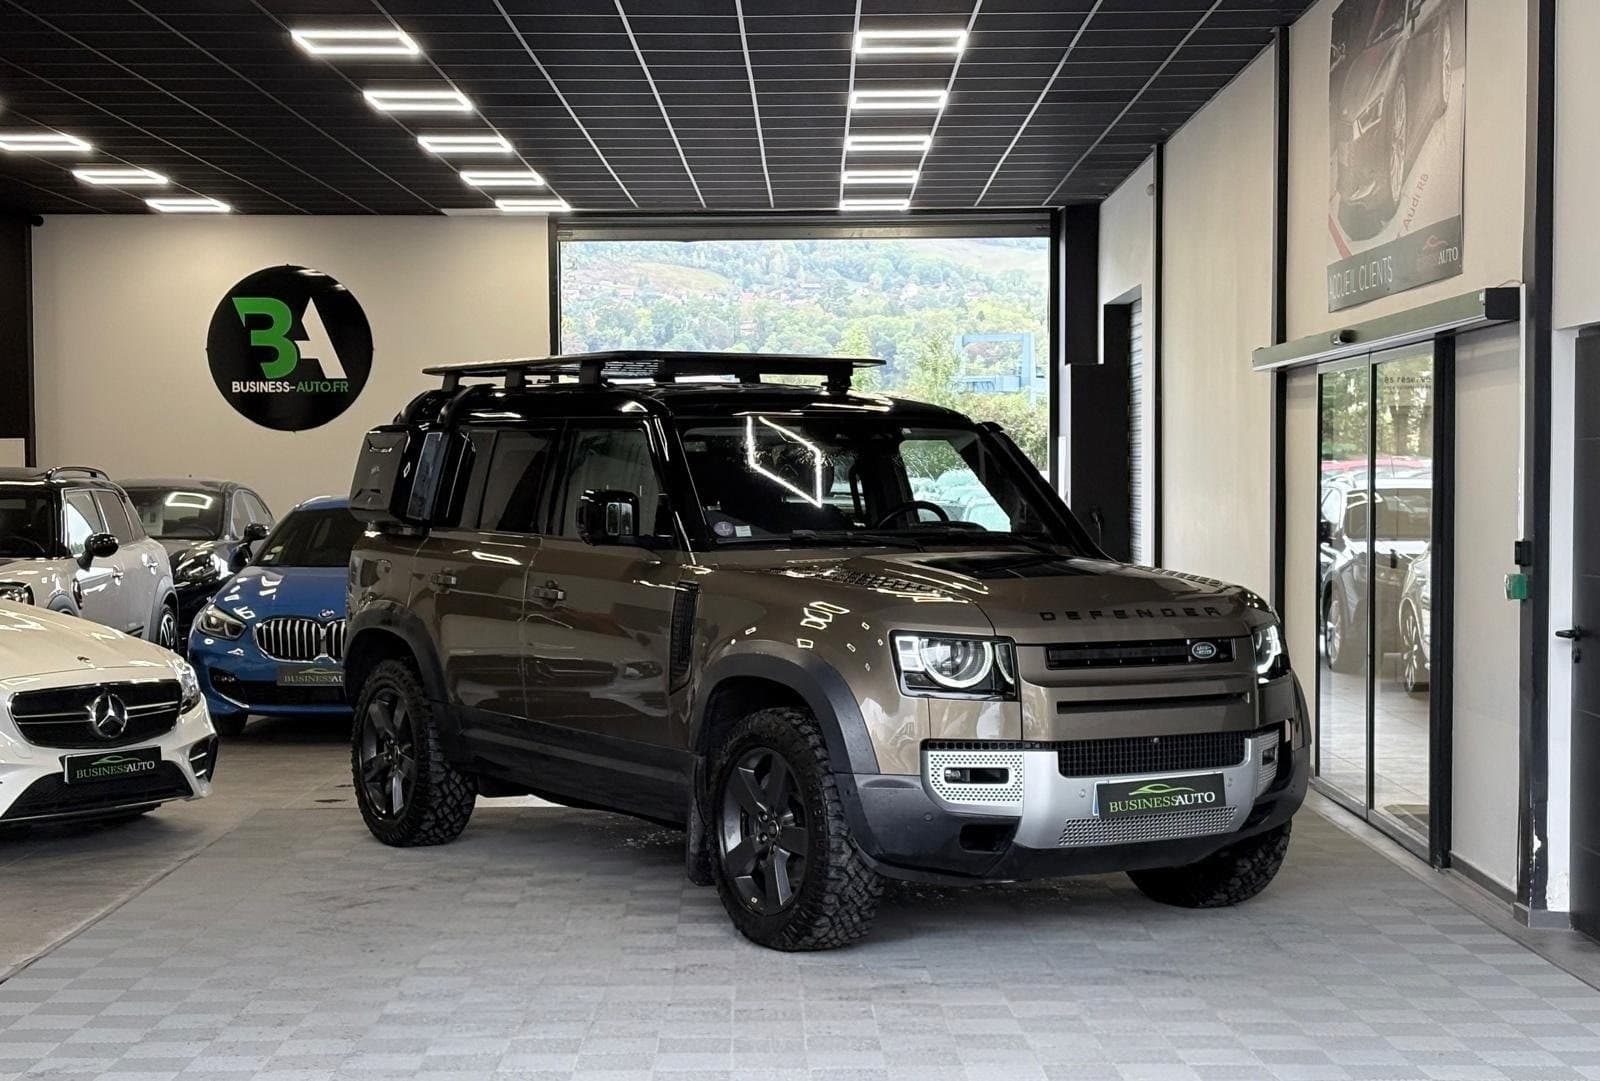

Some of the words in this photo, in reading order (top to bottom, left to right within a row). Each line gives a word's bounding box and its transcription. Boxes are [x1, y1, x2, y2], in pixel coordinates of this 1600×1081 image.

[1403, 194, 1421, 232] Audi
[1359, 255, 1393, 291] CLIENTS
[232, 381, 349, 393] BUSINESS-AUTO.FR
[1040, 606, 1222, 621] DEFENDER
